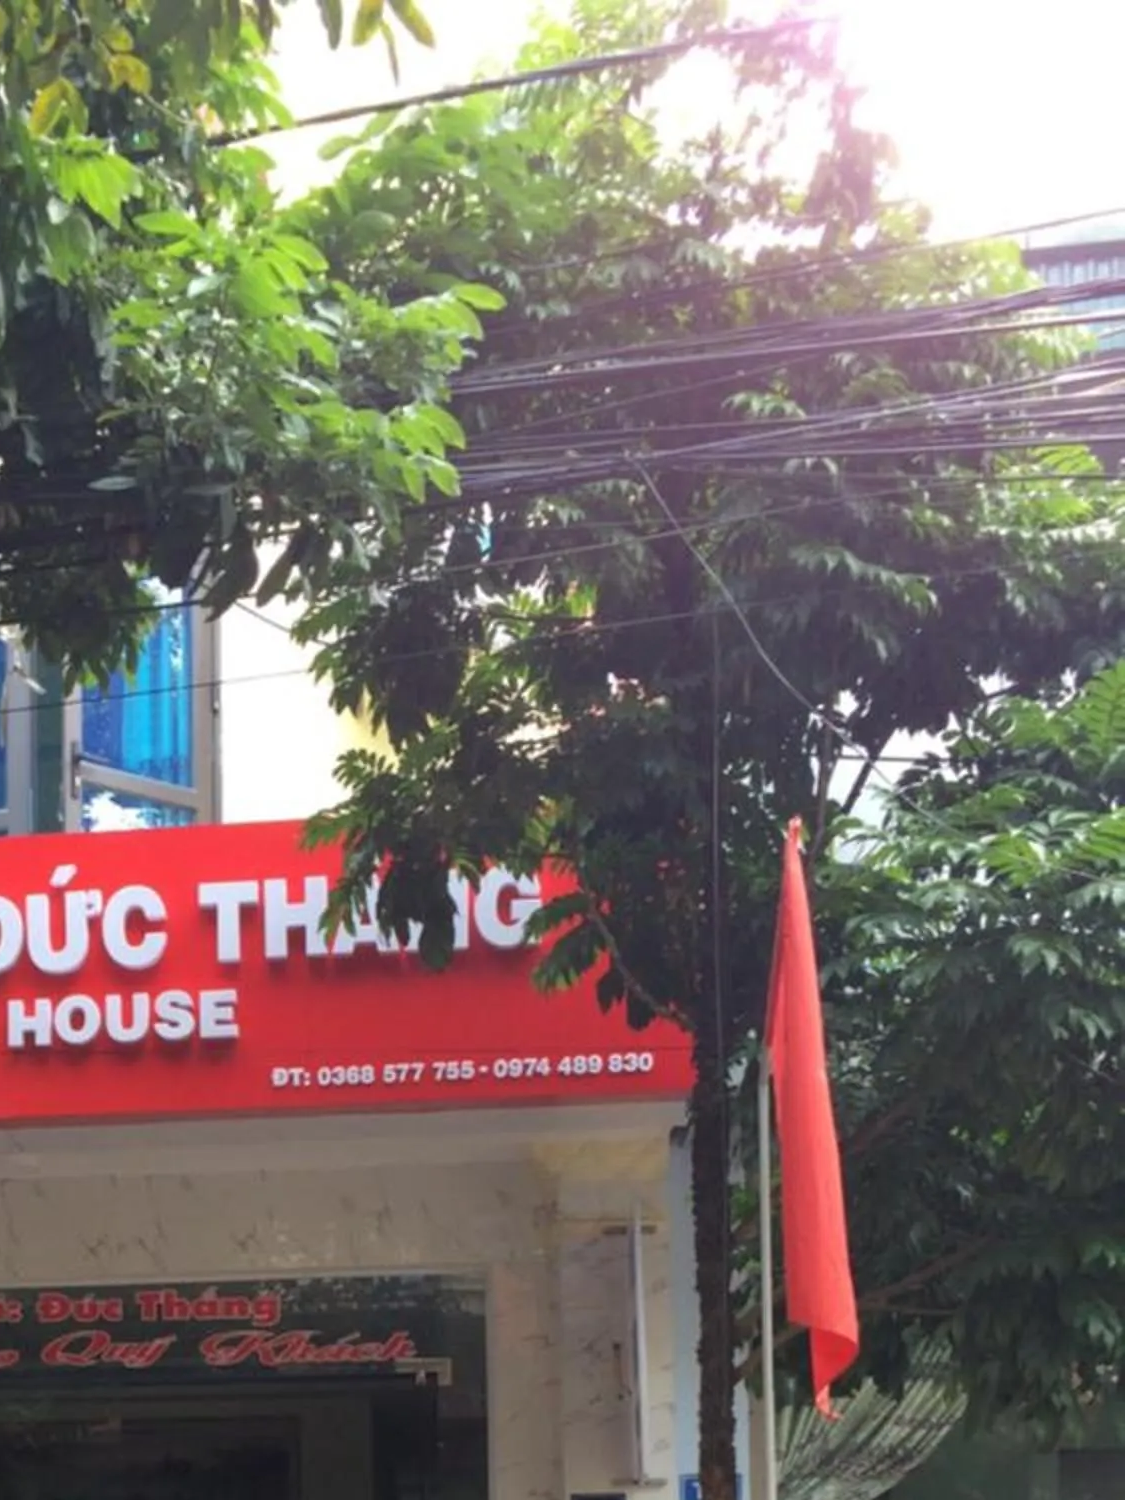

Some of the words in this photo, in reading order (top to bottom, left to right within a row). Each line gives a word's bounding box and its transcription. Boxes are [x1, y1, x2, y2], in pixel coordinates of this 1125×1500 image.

[6, 988, 241, 1048] HOUSE
[271, 1067, 311, 1087] ĐT:
[317, 1065, 375, 1085] 0368
[382, 1063, 425, 1083] 577
[432, 1060, 475, 1081] 755
[493, 1058, 551, 1079] 0974
[557, 1055, 603, 1075] 489
[608, 1052, 655, 1073] 830
